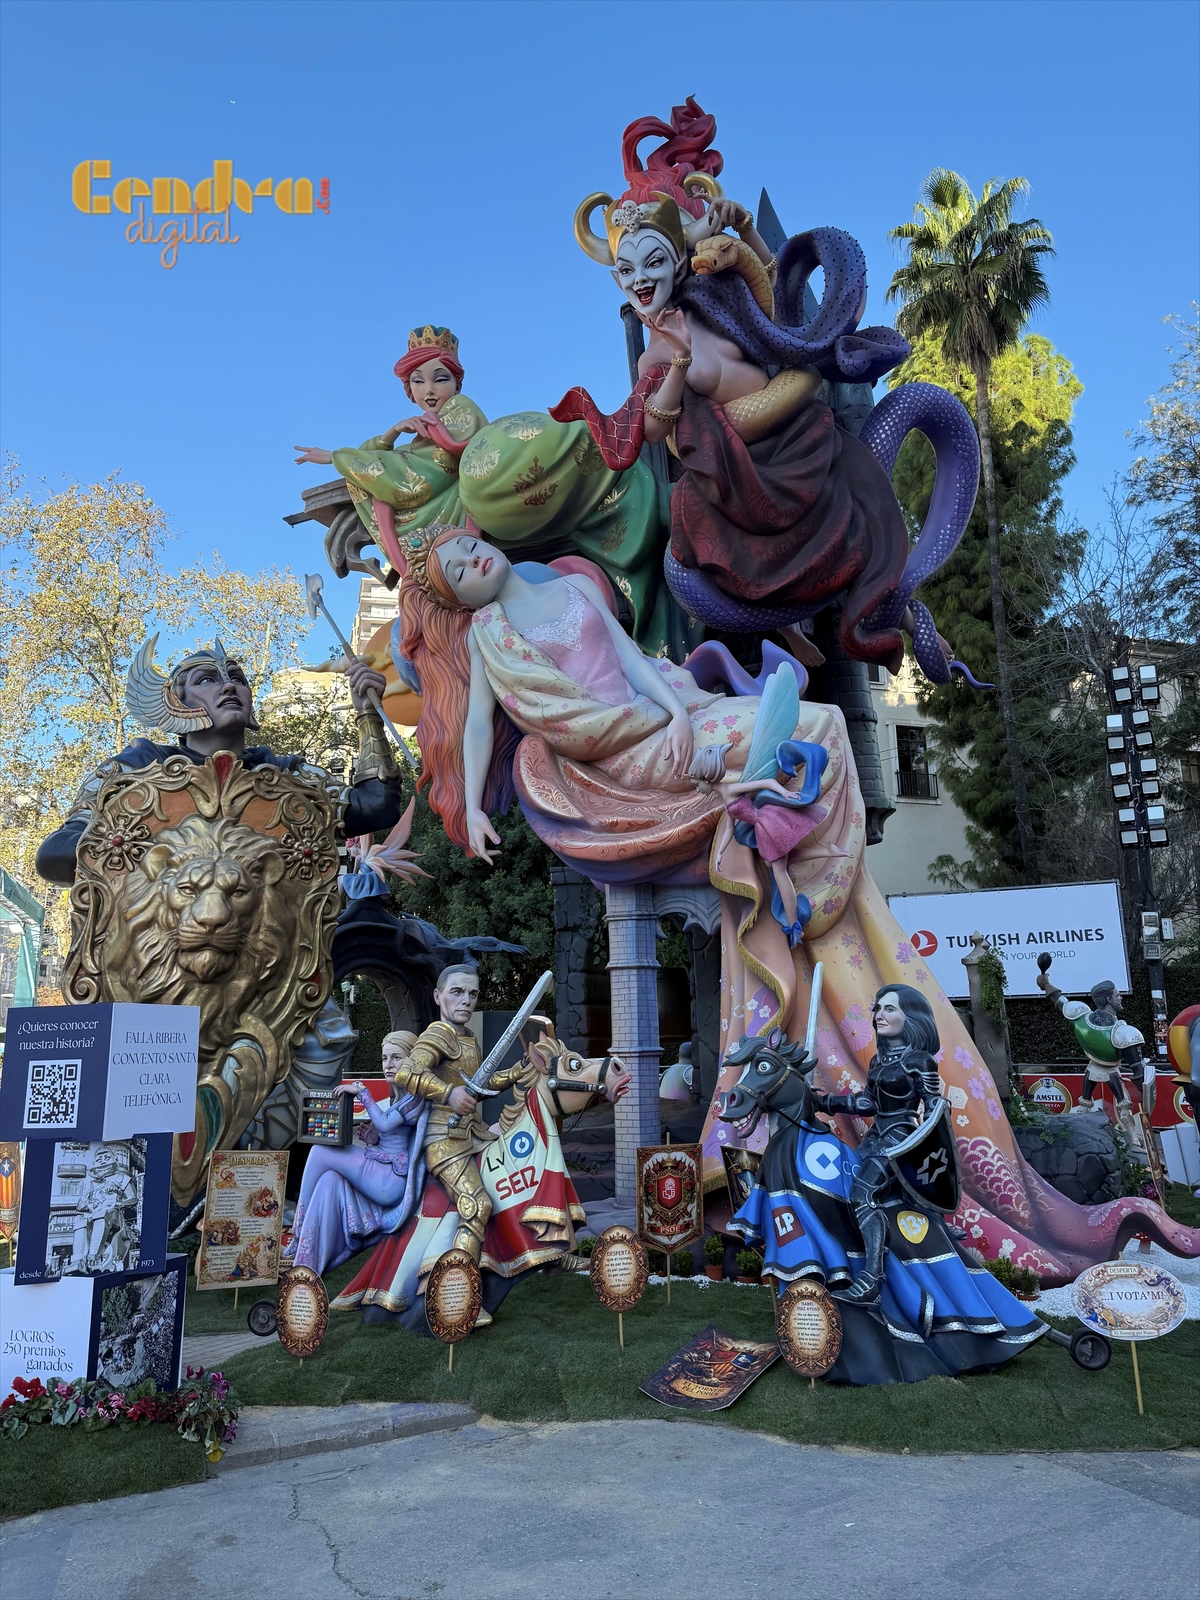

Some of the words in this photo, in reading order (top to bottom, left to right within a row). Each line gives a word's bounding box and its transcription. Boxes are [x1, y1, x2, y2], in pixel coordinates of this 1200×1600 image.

[1026, 928, 1105, 945] AIRLINES
[1011, 952, 1038, 960] YOUR
[1040, 950, 1076, 959] ORLD
[17, 1021, 58, 1035] ¿Quieres
[60, 1019, 99, 1031] conocer
[19, 1040, 55, 1050] nuestra
[56, 1036, 96, 1049] historia?
[125, 1032, 154, 1044] FALLA
[155, 1032, 187, 1044] RIBERA
[112, 1052, 167, 1066] CONVENTO
[168, 1052, 197, 1064] SANTA
[139, 1072, 171, 1085] CLARA
[122, 1092, 182, 1108] TELEFÓNICA
[774, 1212, 795, 1237] LP
[140, 1259, 155, 1268] 1973
[19, 1269, 42, 1279] desde
[10, 1329, 55, 1344] LOGROS
[2, 1342, 22, 1355] 250
[23, 1345, 66, 1358] premios
[25, 1357, 74, 1374] ganados
